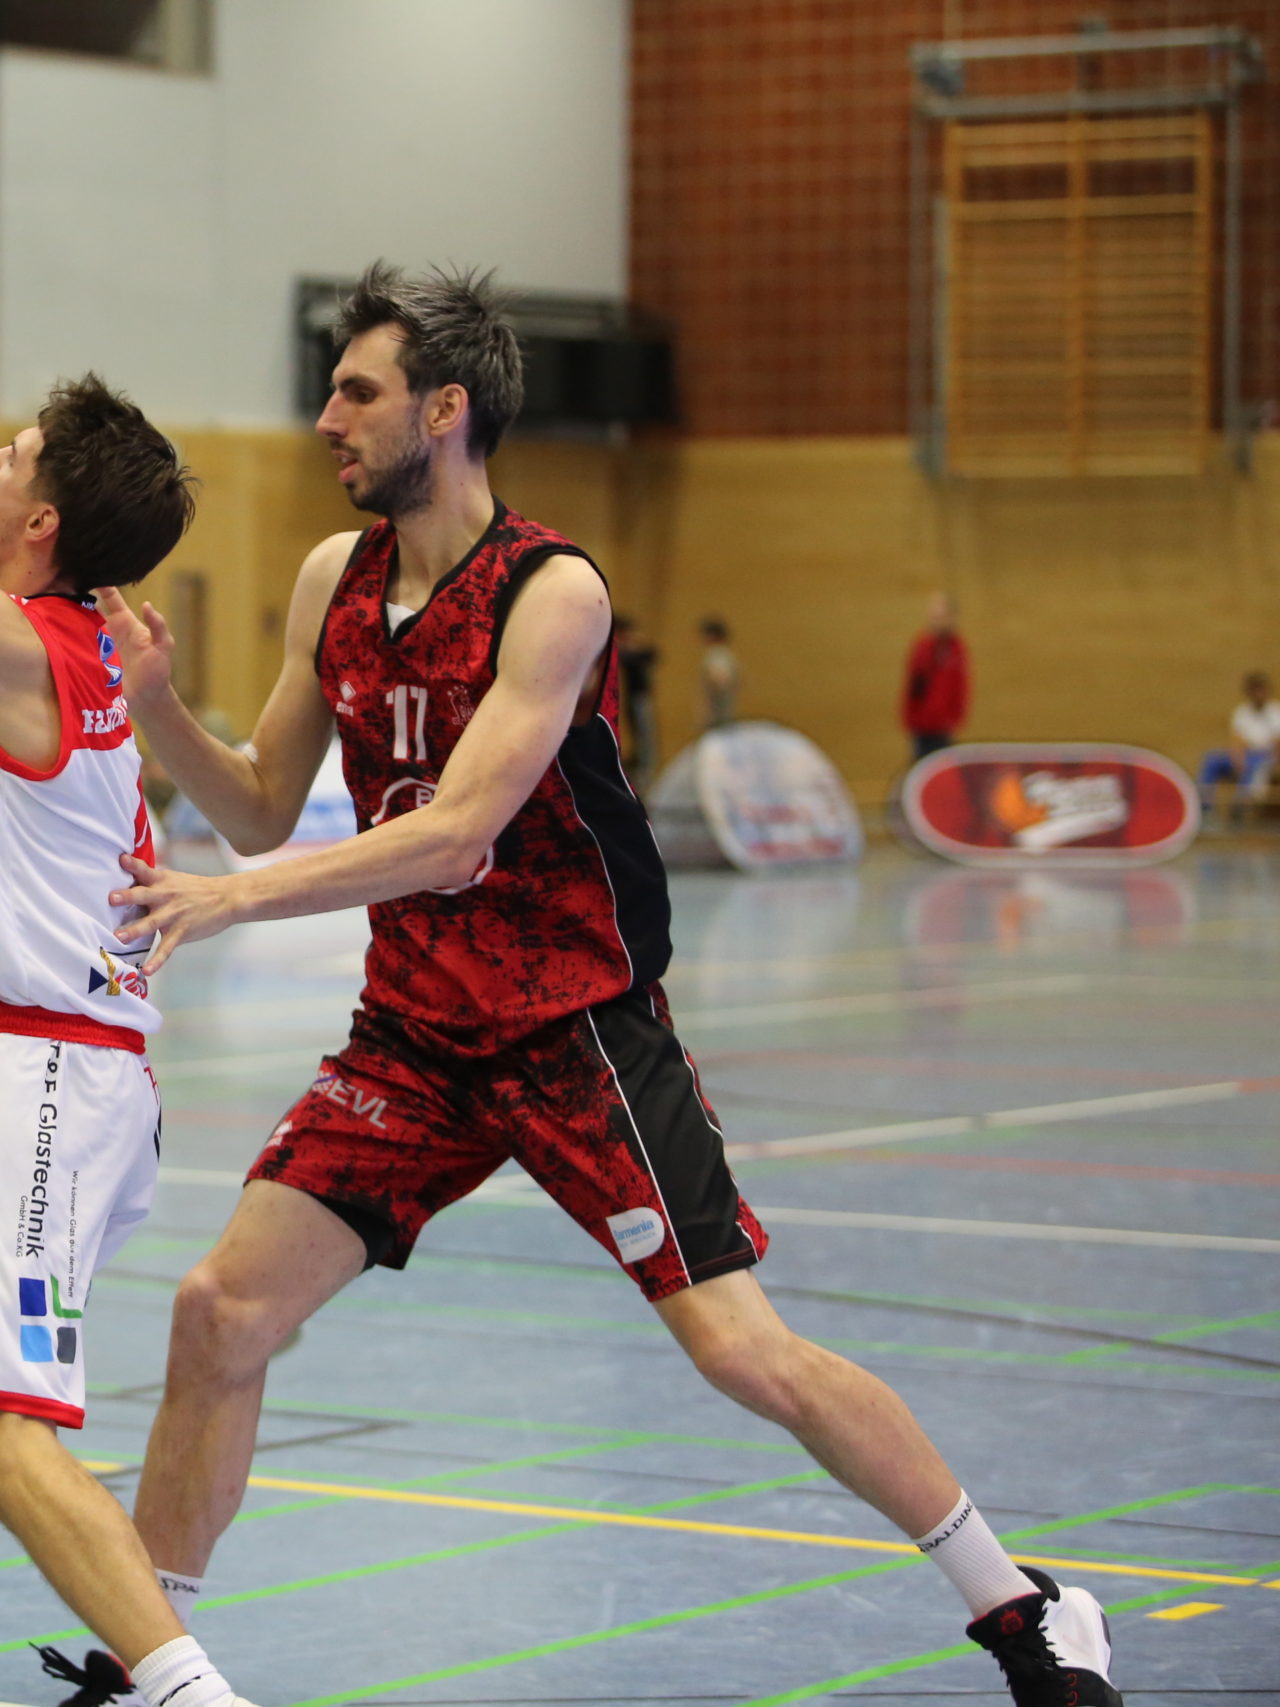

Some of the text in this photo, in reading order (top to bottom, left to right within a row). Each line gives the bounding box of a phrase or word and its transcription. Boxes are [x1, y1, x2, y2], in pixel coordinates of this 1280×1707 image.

[326, 1079, 387, 1129] EVL
[25, 1103, 58, 1259] Glastechnik
[19, 1195, 28, 1221] GmbH
